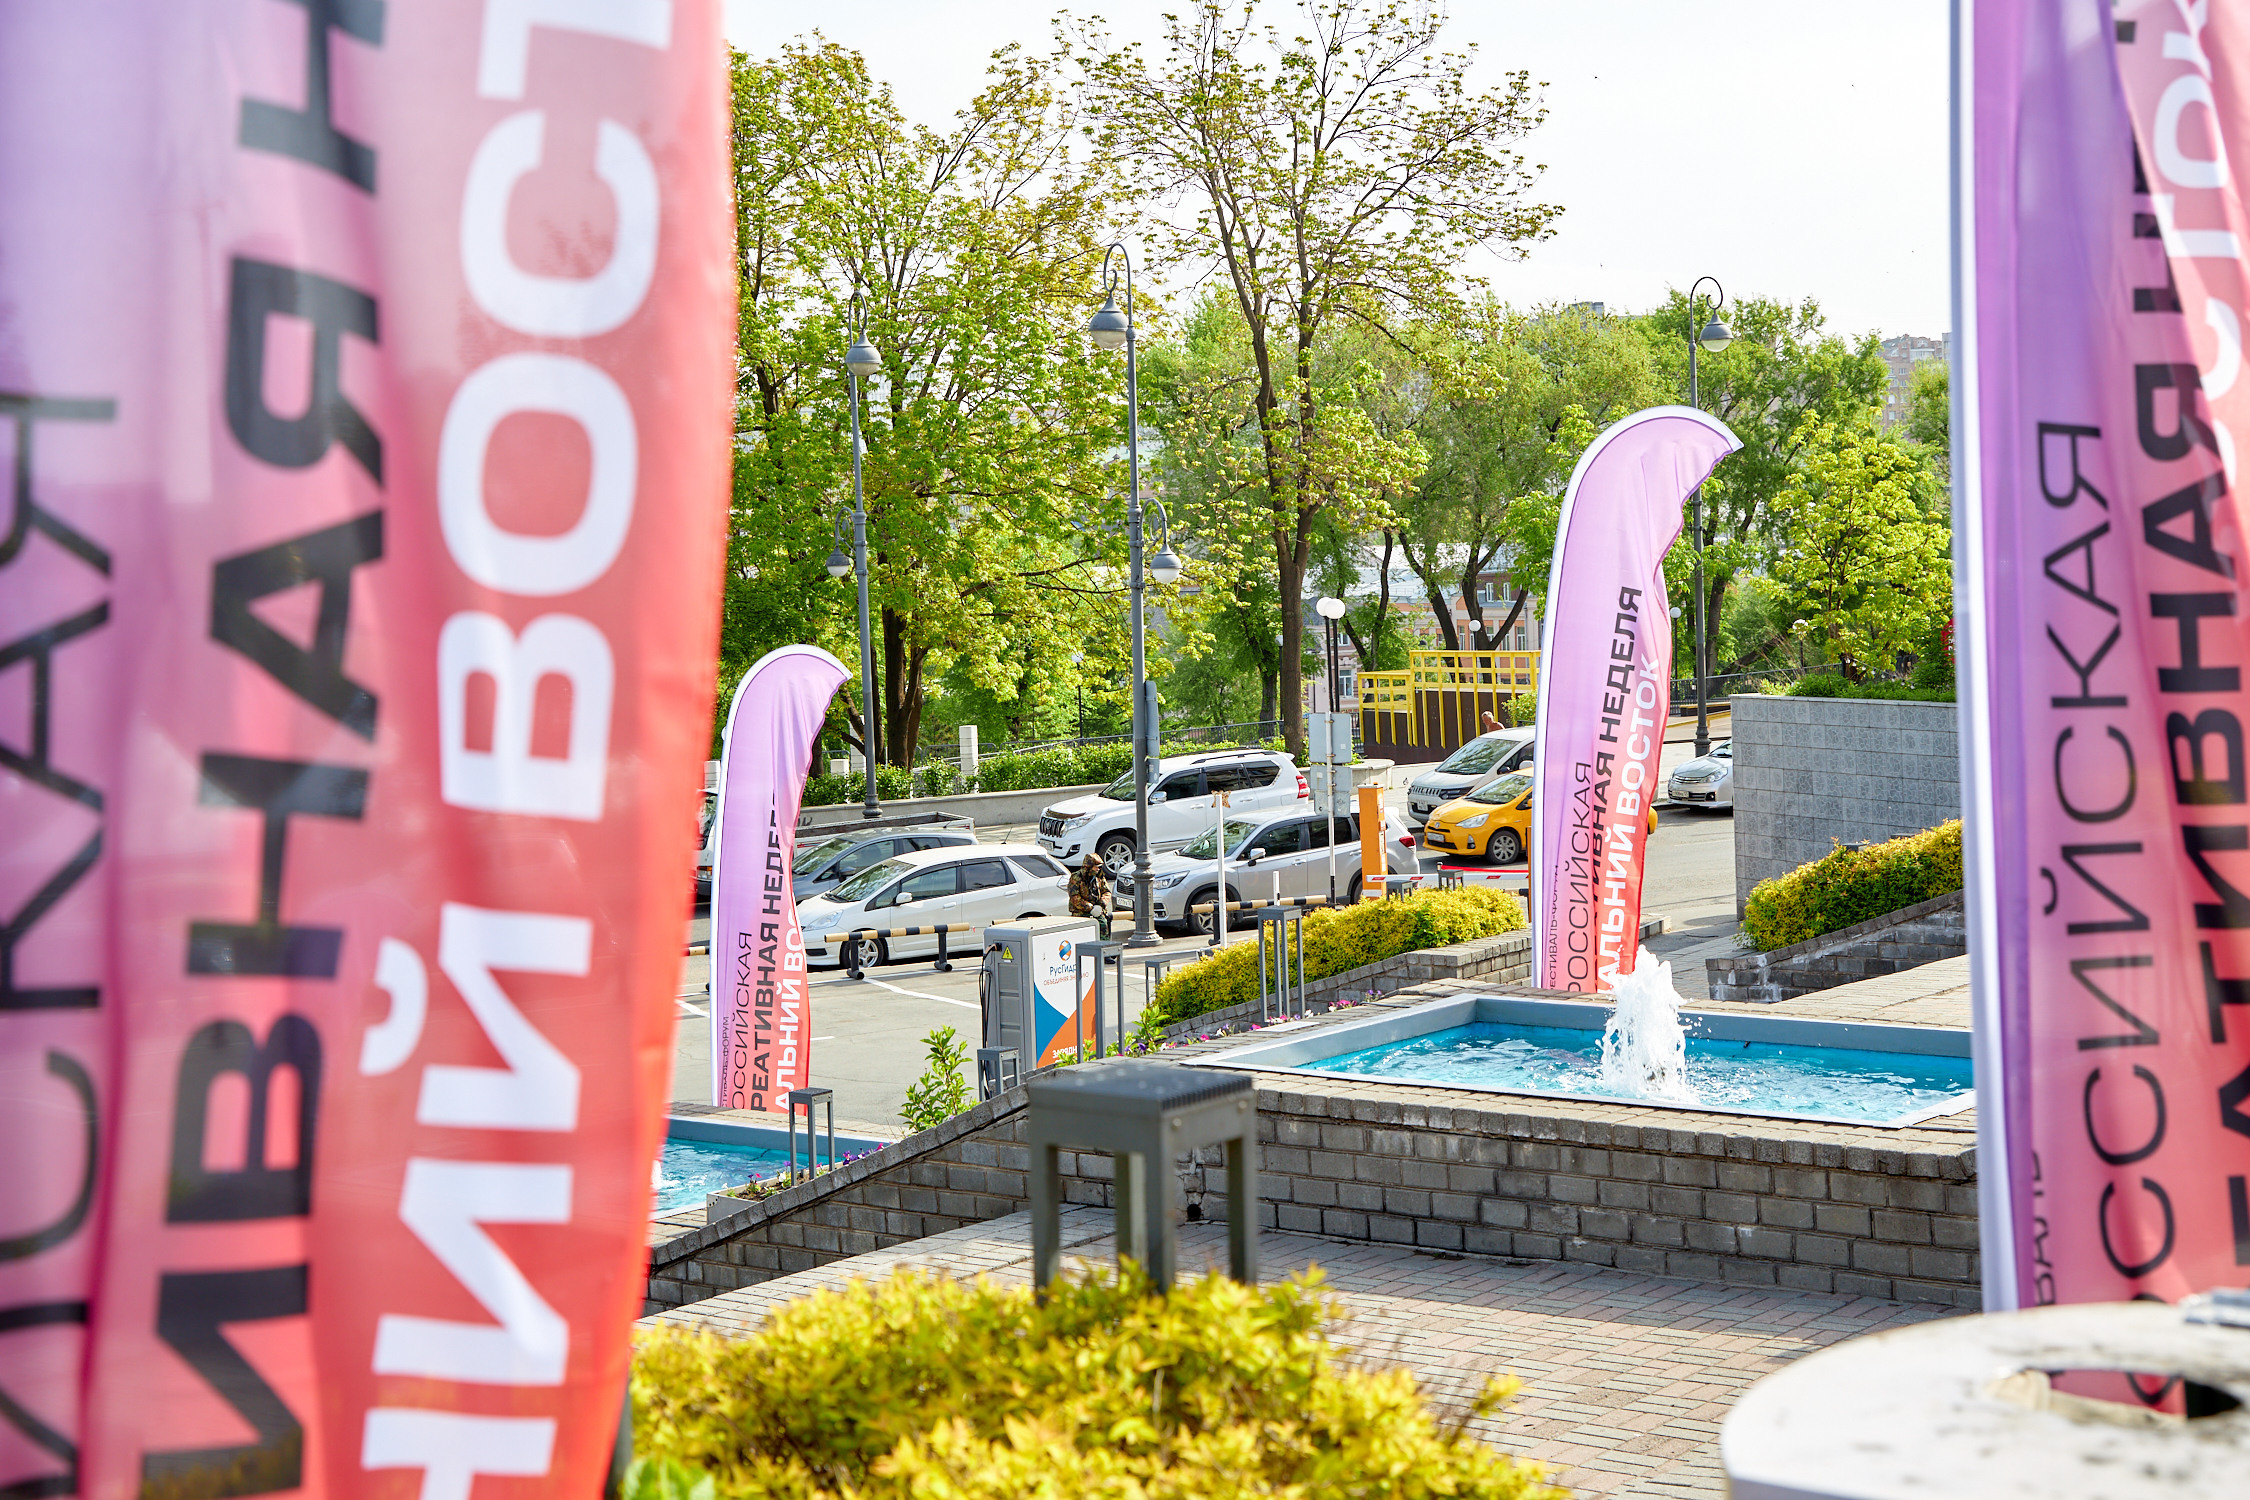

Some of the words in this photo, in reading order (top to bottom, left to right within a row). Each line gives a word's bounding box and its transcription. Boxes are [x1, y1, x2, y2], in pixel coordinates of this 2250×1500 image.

[1598, 586, 1642, 744] НЕДЕЛЯ
[1616, 653, 1659, 817] ВОСТОК
[1565, 762, 1591, 993] РОССИЙСКАЯ
[731, 932, 752, 1109] ОССИЙСКАЯ
[750, 922, 779, 1112] РЕАТИВНАЯ
